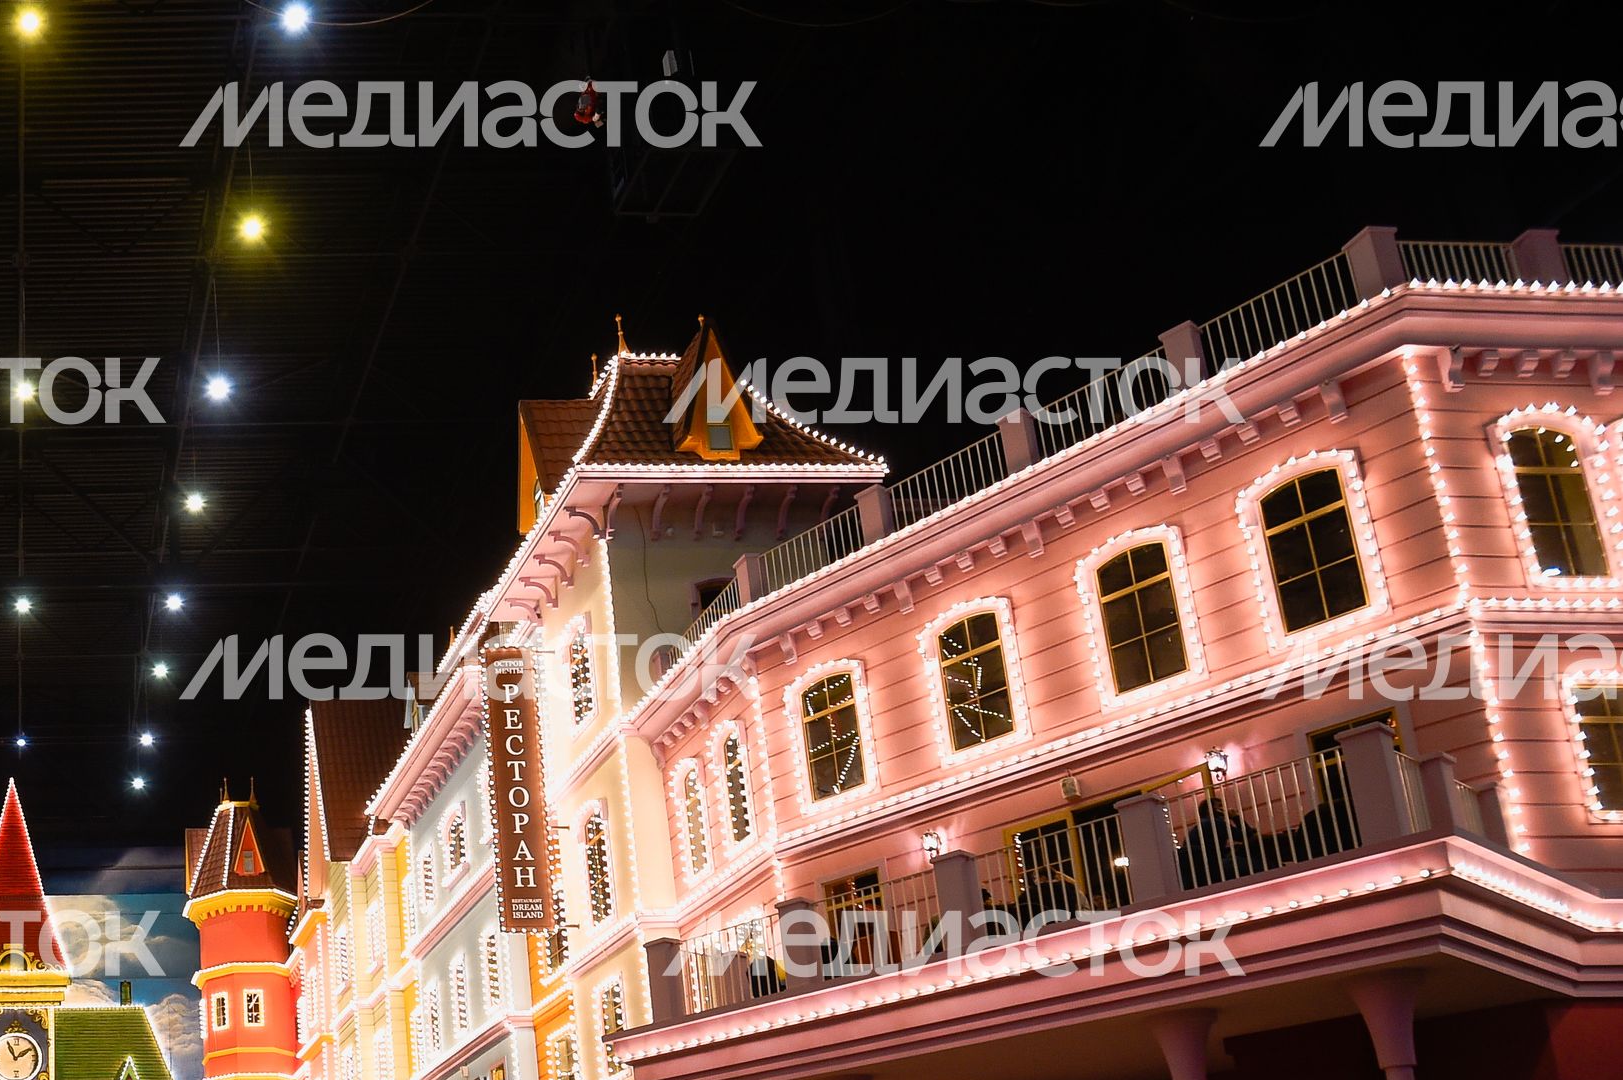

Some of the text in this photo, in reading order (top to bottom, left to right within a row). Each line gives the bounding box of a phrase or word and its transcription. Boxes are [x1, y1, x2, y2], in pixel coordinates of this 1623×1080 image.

[502, 683, 537, 888] РЕСТОРАН
[512, 903, 543, 911] DREAM
[512, 911, 544, 919] ISLAND
